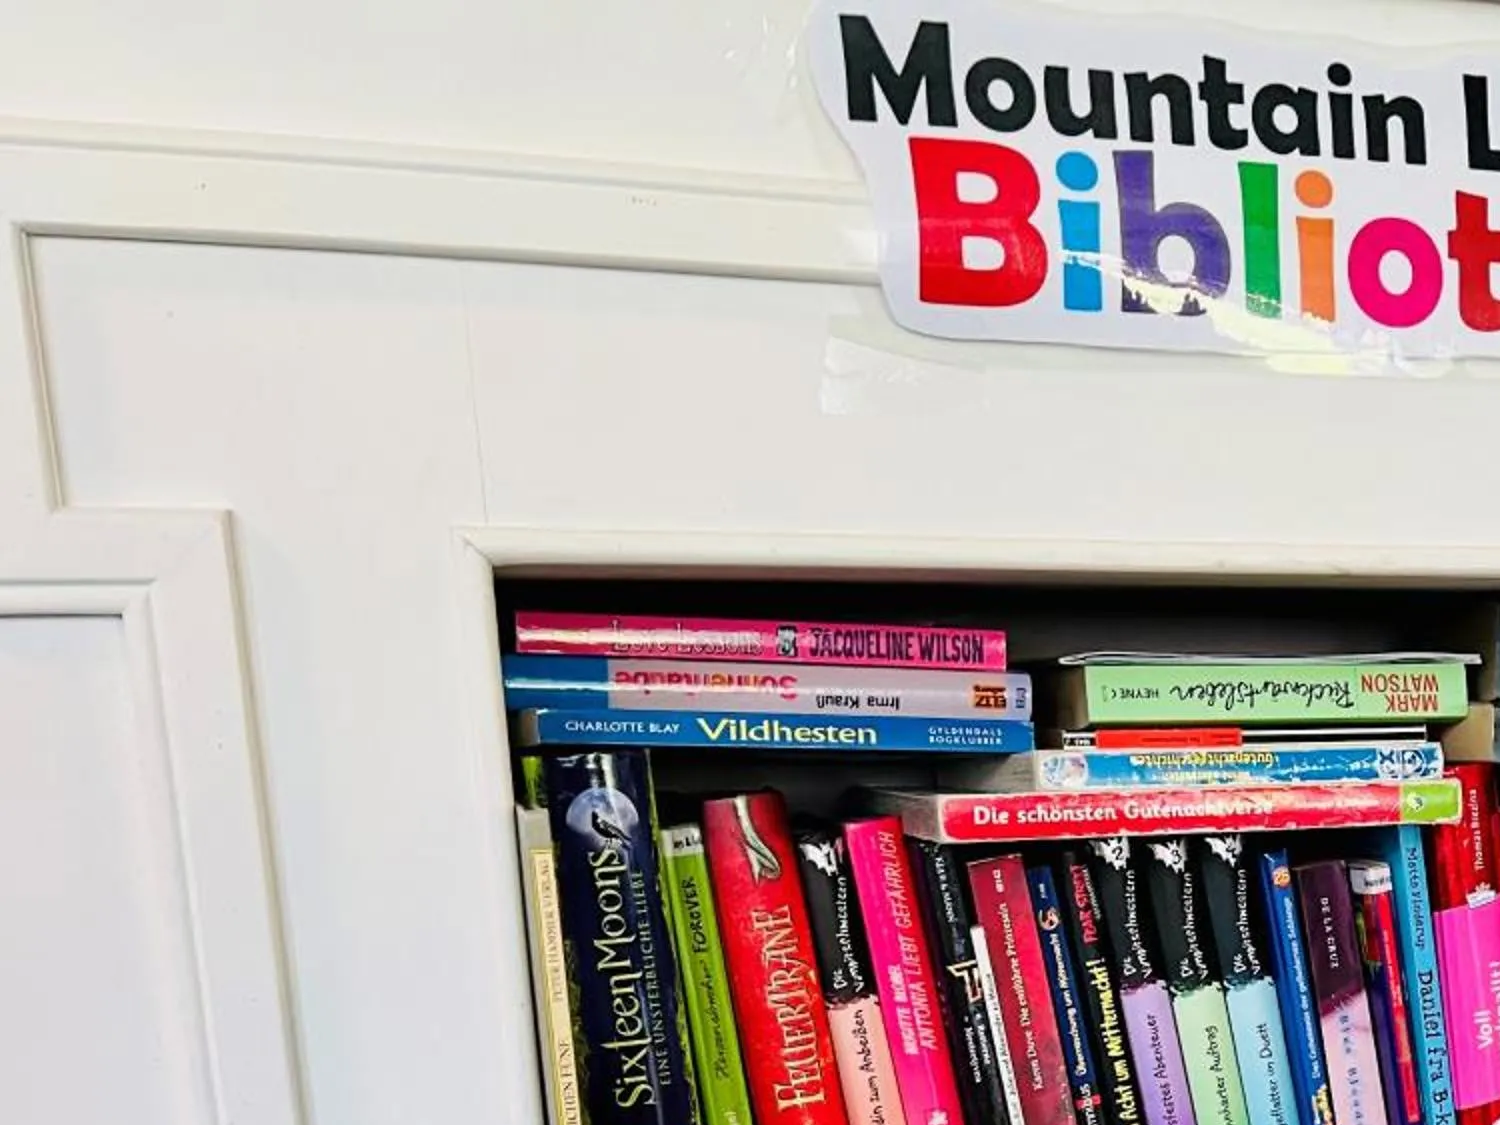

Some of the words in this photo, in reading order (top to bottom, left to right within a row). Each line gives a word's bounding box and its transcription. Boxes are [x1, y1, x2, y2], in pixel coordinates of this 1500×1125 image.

[839, 14, 1426, 166] Mountain
[808, 627, 914, 663] JACQUELINE
[917, 633, 984, 665] WILSON
[815, 692, 860, 711] Krauß
[866, 692, 900, 711] Irma
[1121, 686, 1160, 700] HEYNE
[1170, 677, 1355, 712] Rückwärtsleben
[1361, 672, 1439, 695] WATSON
[1384, 692, 1439, 714] MARK
[564, 720, 645, 733] CHARLOTTE
[648, 721, 681, 734] BLAY
[696, 717, 877, 746] Vildhesten
[974, 804, 1012, 826] Die
[1016, 799, 1118, 826] schönsten
[1470, 831, 1486, 872] Thomas
[632, 871, 650, 914] LIEBE
[878, 830, 915, 929] GEFÄHRLICH
[588, 849, 637, 972] Moons
[1319, 896, 1331, 913] DE
[1323, 916, 1333, 933] LA
[898, 934, 922, 976] LIEBT
[1123, 956, 1138, 977] Die
[1179, 957, 1194, 978] Die
[1233, 953, 1248, 974] Die
[637, 918, 668, 1044] UNSTERBLICHE
[832, 968, 848, 990] Die
[908, 980, 938, 1051] ANTONIA
[1019, 1007, 1032, 1027] Die
[1085, 956, 1126, 1058] Mitternacht!
[1418, 968, 1442, 1039] Daniel
[600, 970, 658, 1108] Sixteen
[851, 1009, 878, 1072] Anbeißen
[1024, 1030, 1041, 1058] Duve
[1259, 1022, 1274, 1059] Duett
[1472, 1007, 1494, 1050] Voll
[1147, 1014, 1172, 1080] Abenteuer
[1205, 1025, 1224, 1073] Auftrag
[1428, 1047, 1446, 1083] fra
[653, 1046, 673, 1086] EINE
[1113, 1058, 1130, 1081] um
[867, 1073, 882, 1104] zum
[1114, 1084, 1138, 1121] Acht
